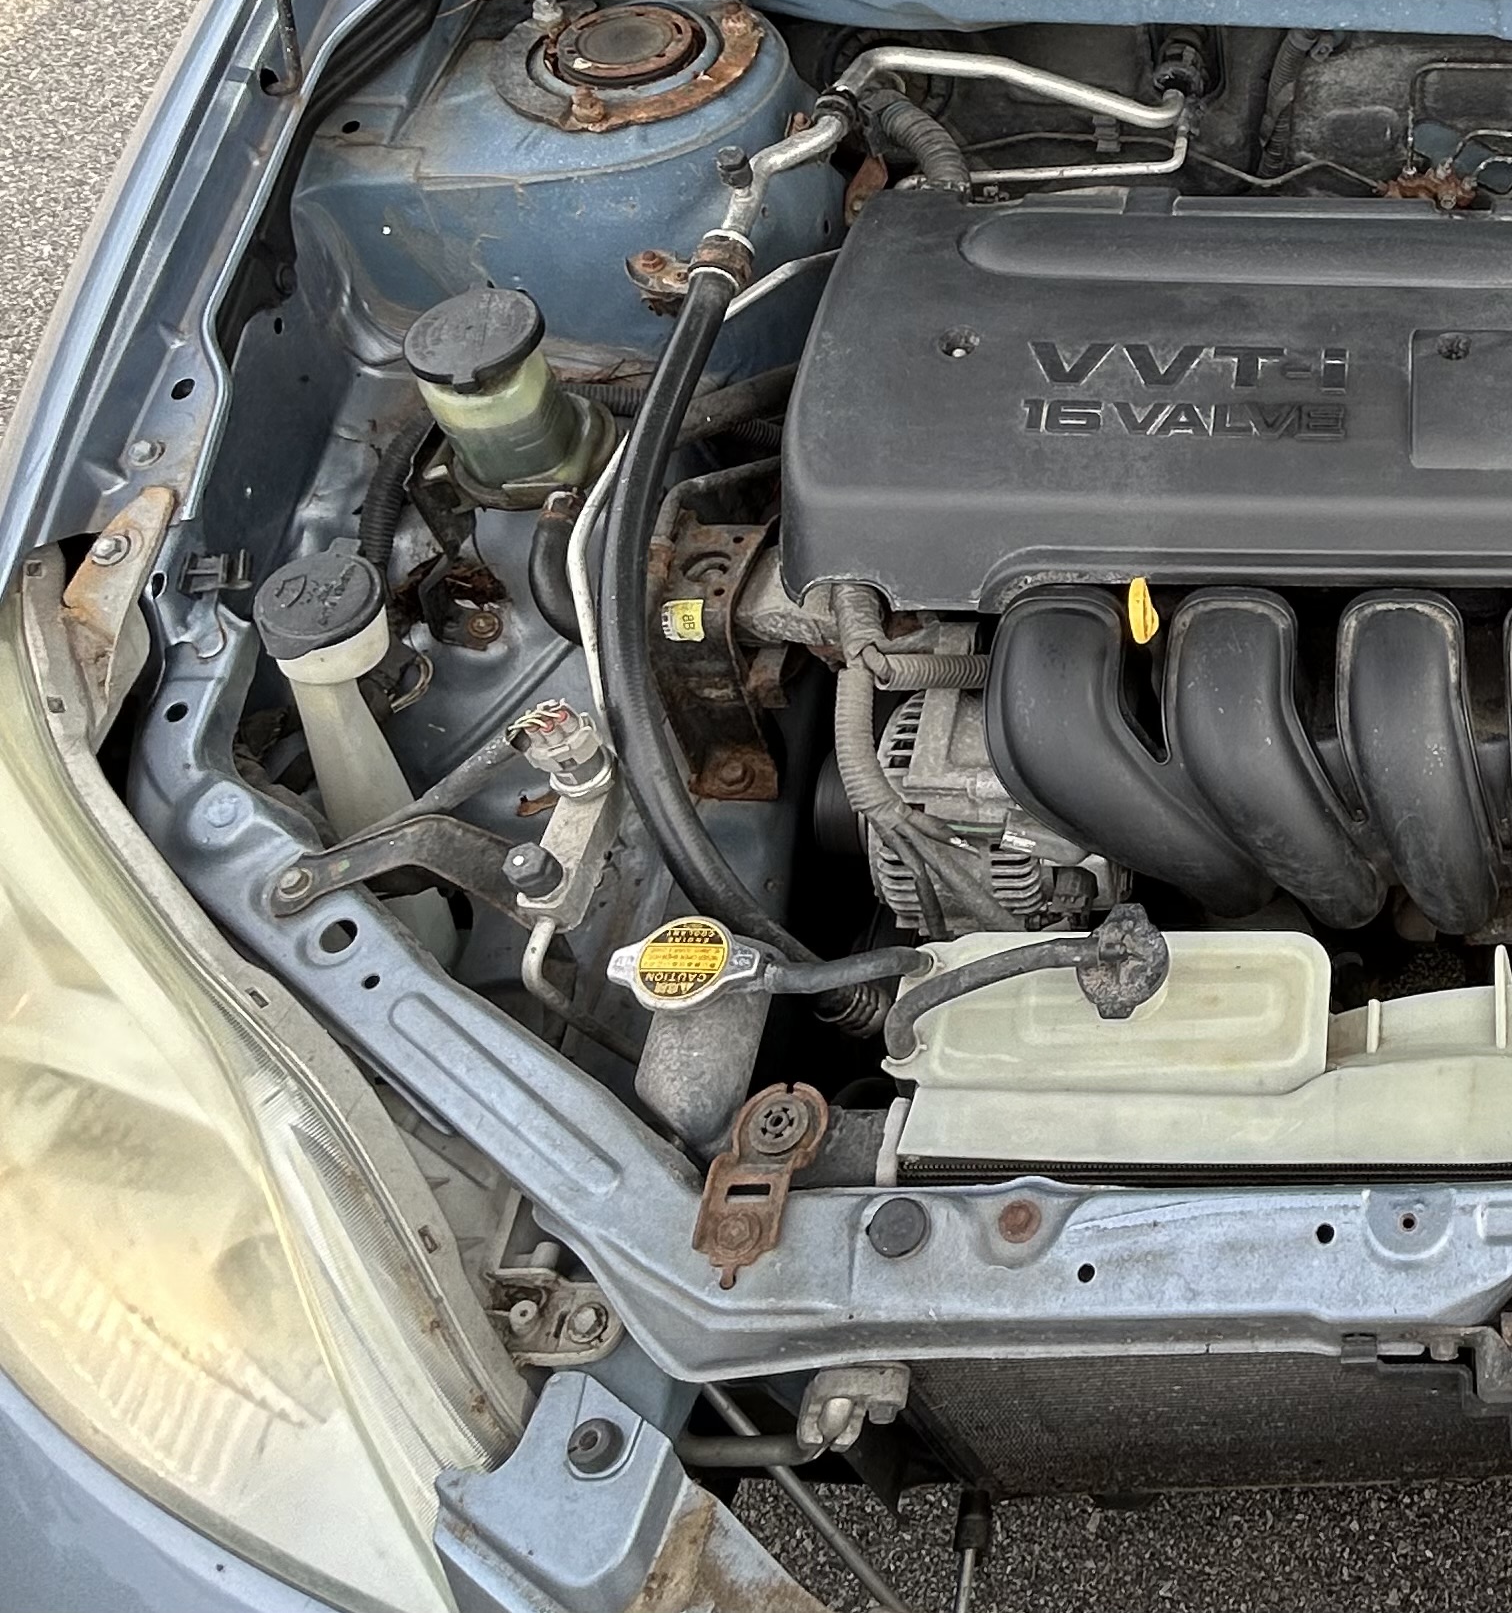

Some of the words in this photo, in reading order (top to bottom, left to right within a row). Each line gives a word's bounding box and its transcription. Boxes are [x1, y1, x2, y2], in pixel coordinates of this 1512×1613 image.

[1027, 340, 1349, 394] VVT-i
[1021, 399, 1103, 437] 16
[1108, 401, 1348, 439] VALVE
[644, 972, 707, 983] CAUTION
